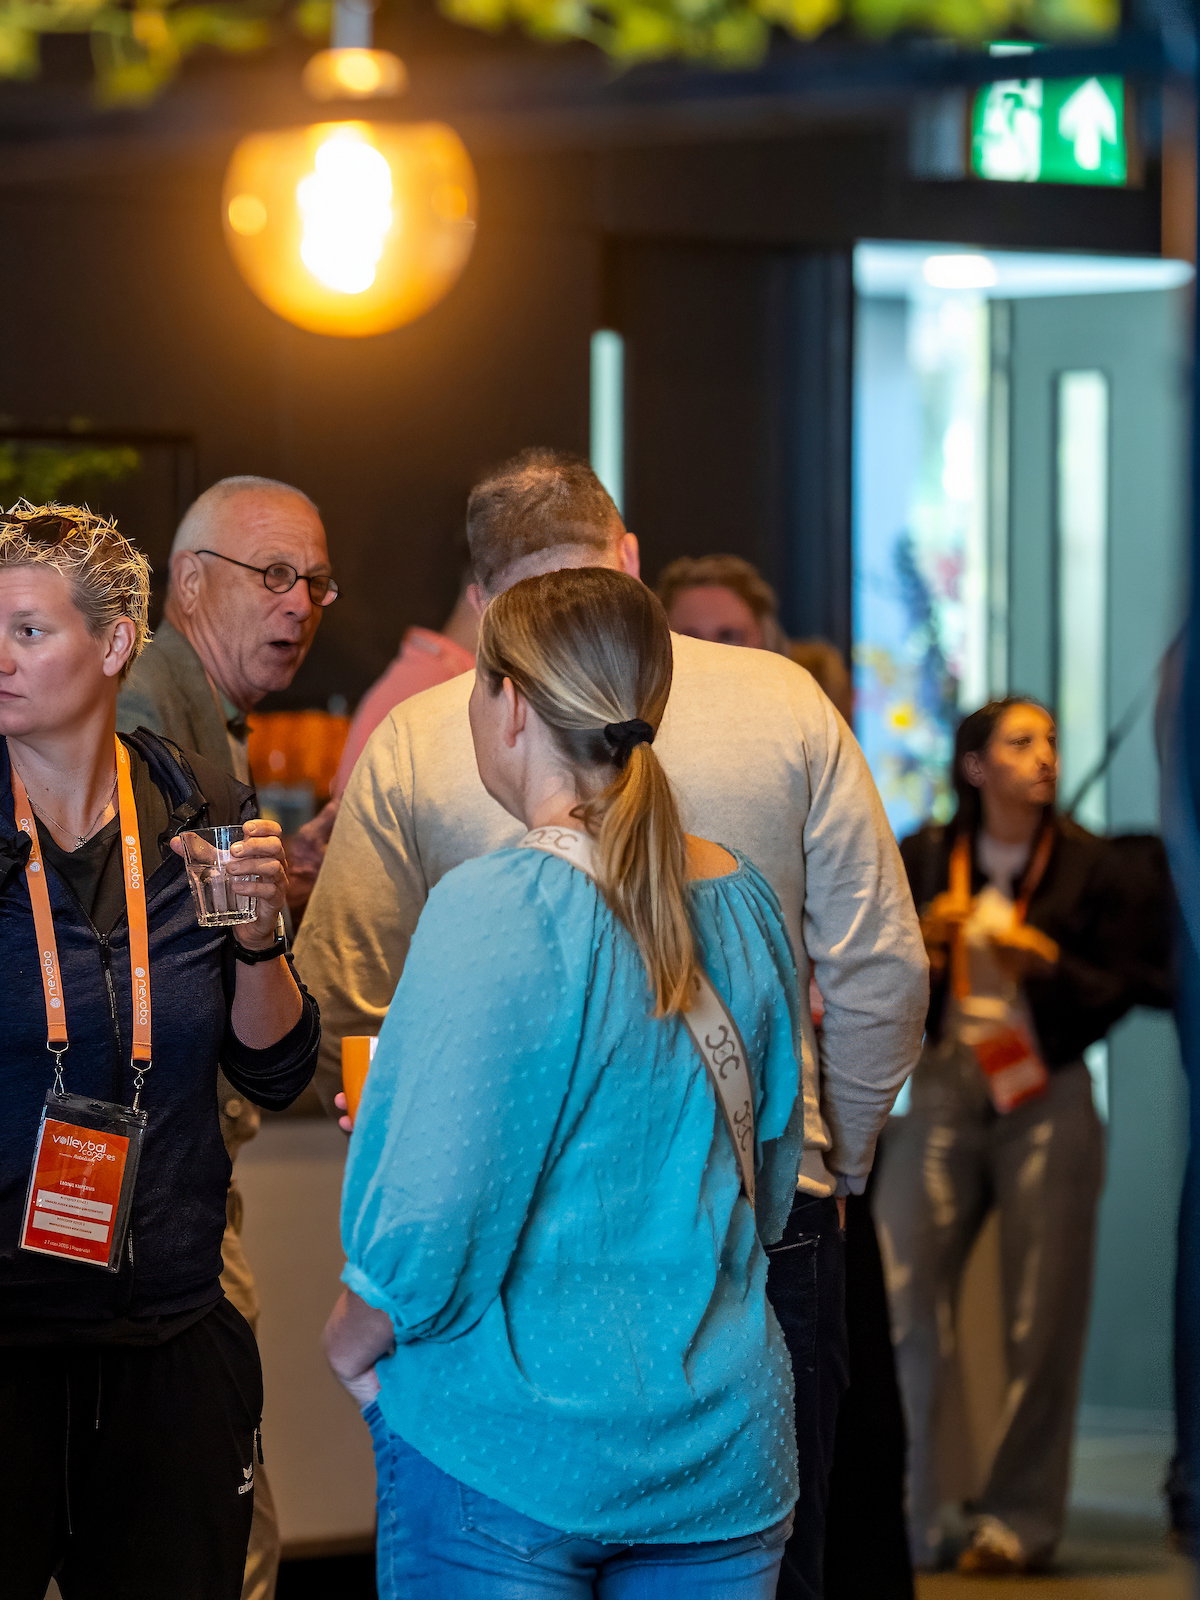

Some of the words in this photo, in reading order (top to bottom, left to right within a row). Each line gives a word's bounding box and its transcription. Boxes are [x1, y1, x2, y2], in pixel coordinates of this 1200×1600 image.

[128, 846, 141, 889] nevobo
[43, 951, 57, 996] nevobo
[139, 979, 150, 1025] nevobo
[52, 1134, 107, 1153] volleybal
[81, 1149, 116, 1162] congres
